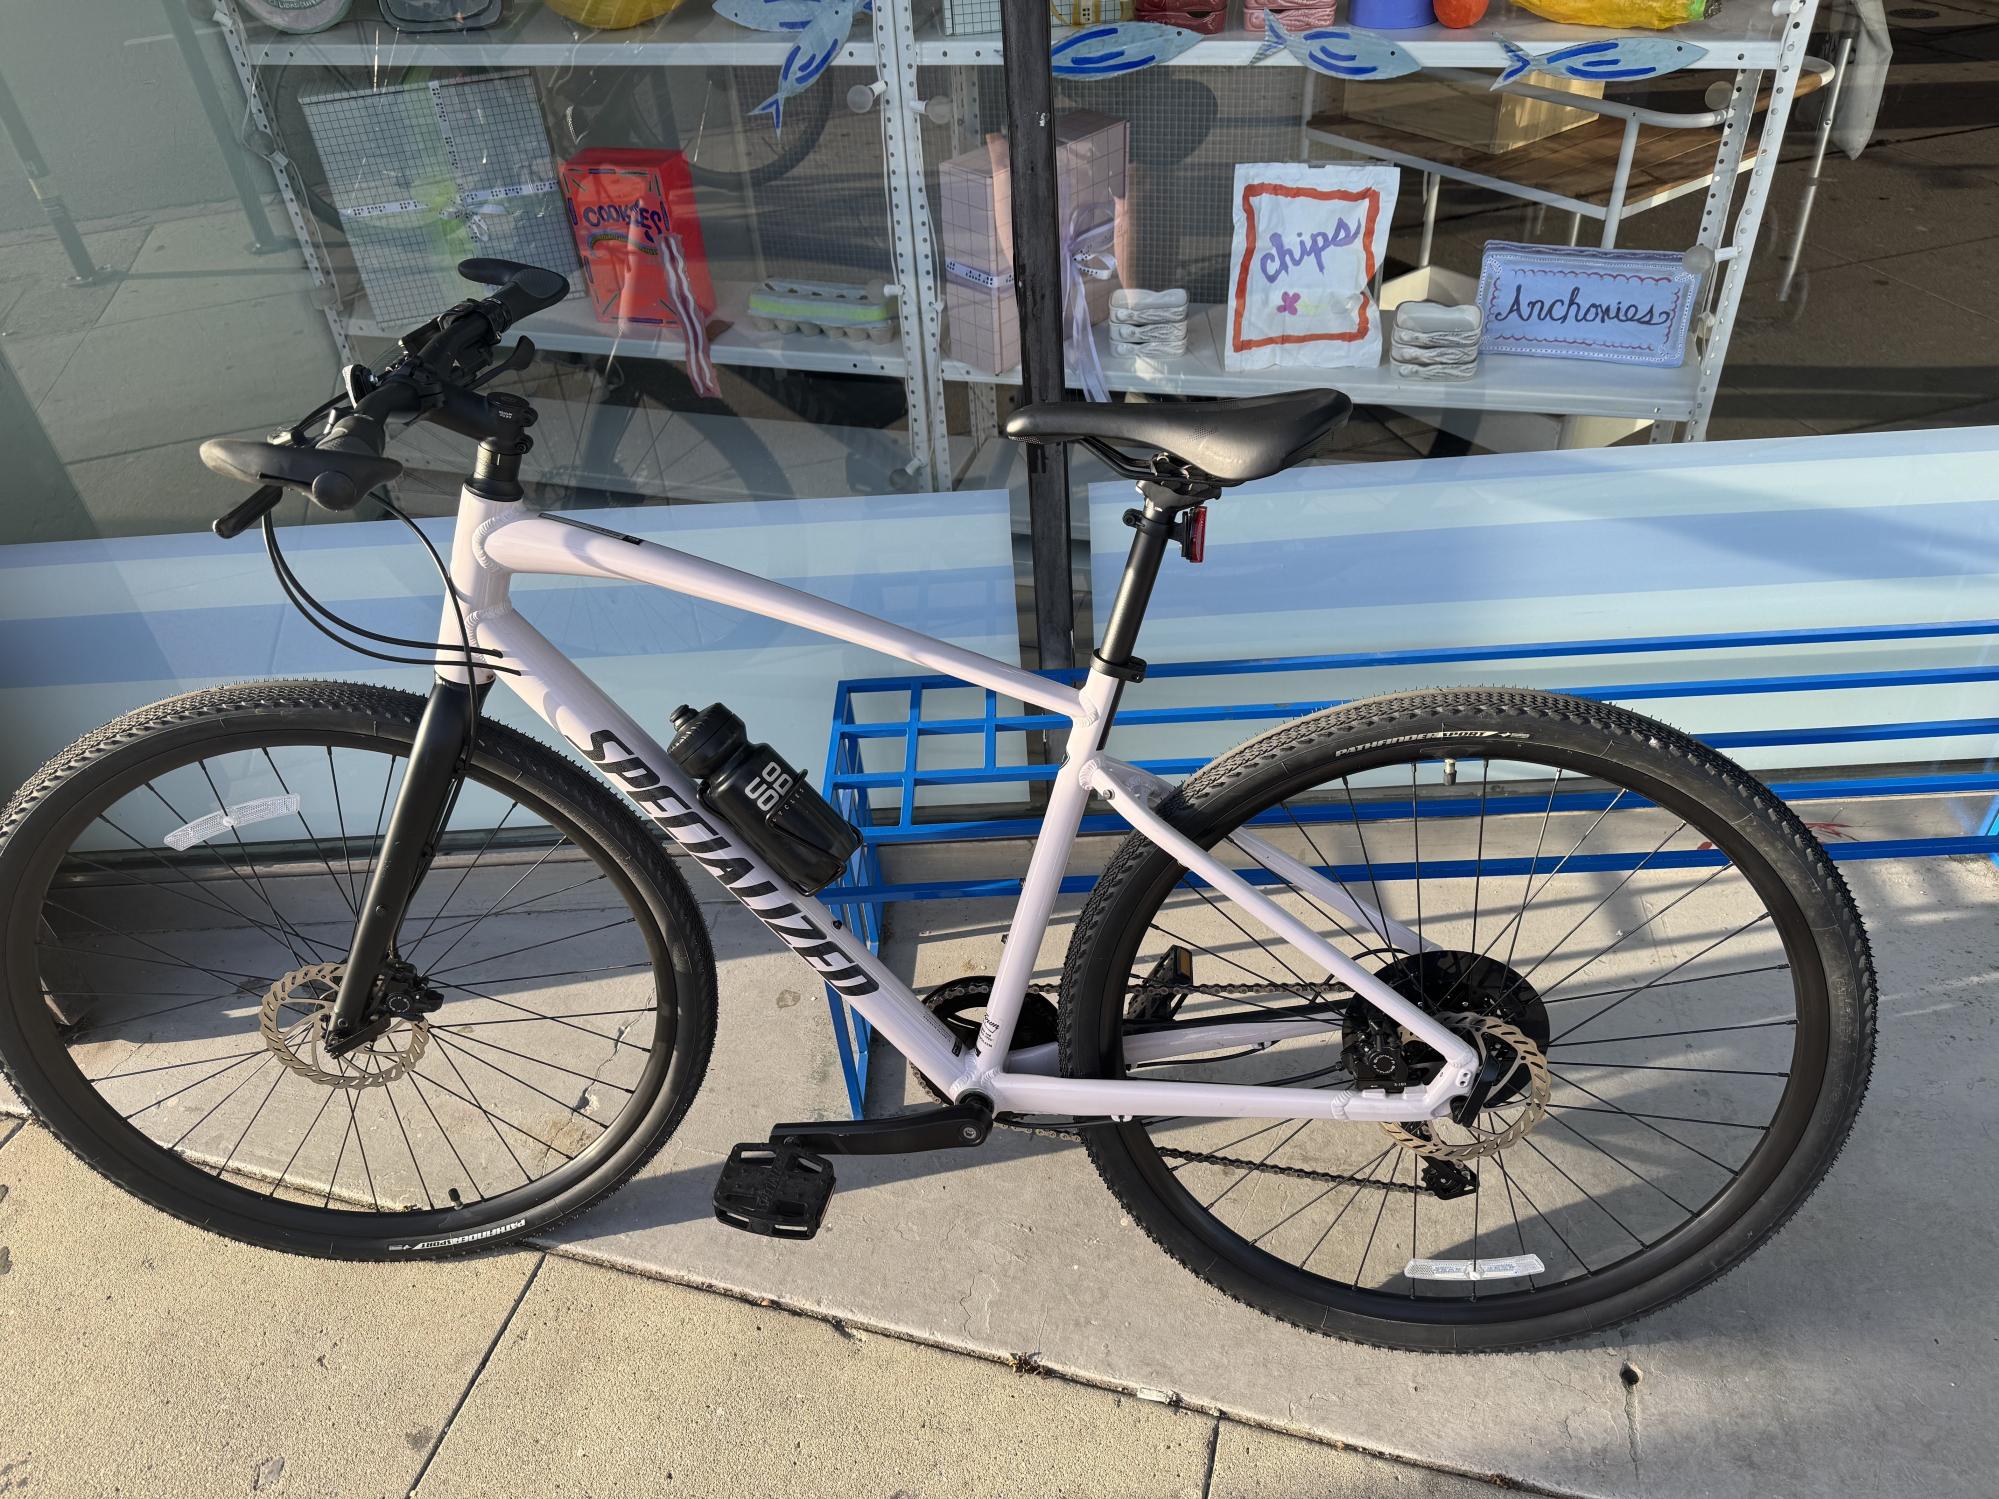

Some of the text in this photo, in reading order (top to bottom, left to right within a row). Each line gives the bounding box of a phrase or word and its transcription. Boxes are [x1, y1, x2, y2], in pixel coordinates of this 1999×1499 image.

[1260, 217, 1361, 284] chips
[1335, 732, 1438, 757] PATHFINDER
[566, 729, 879, 996] SPECIALIZED
[421, 1218, 526, 1249] PATHFINDER SPORT
